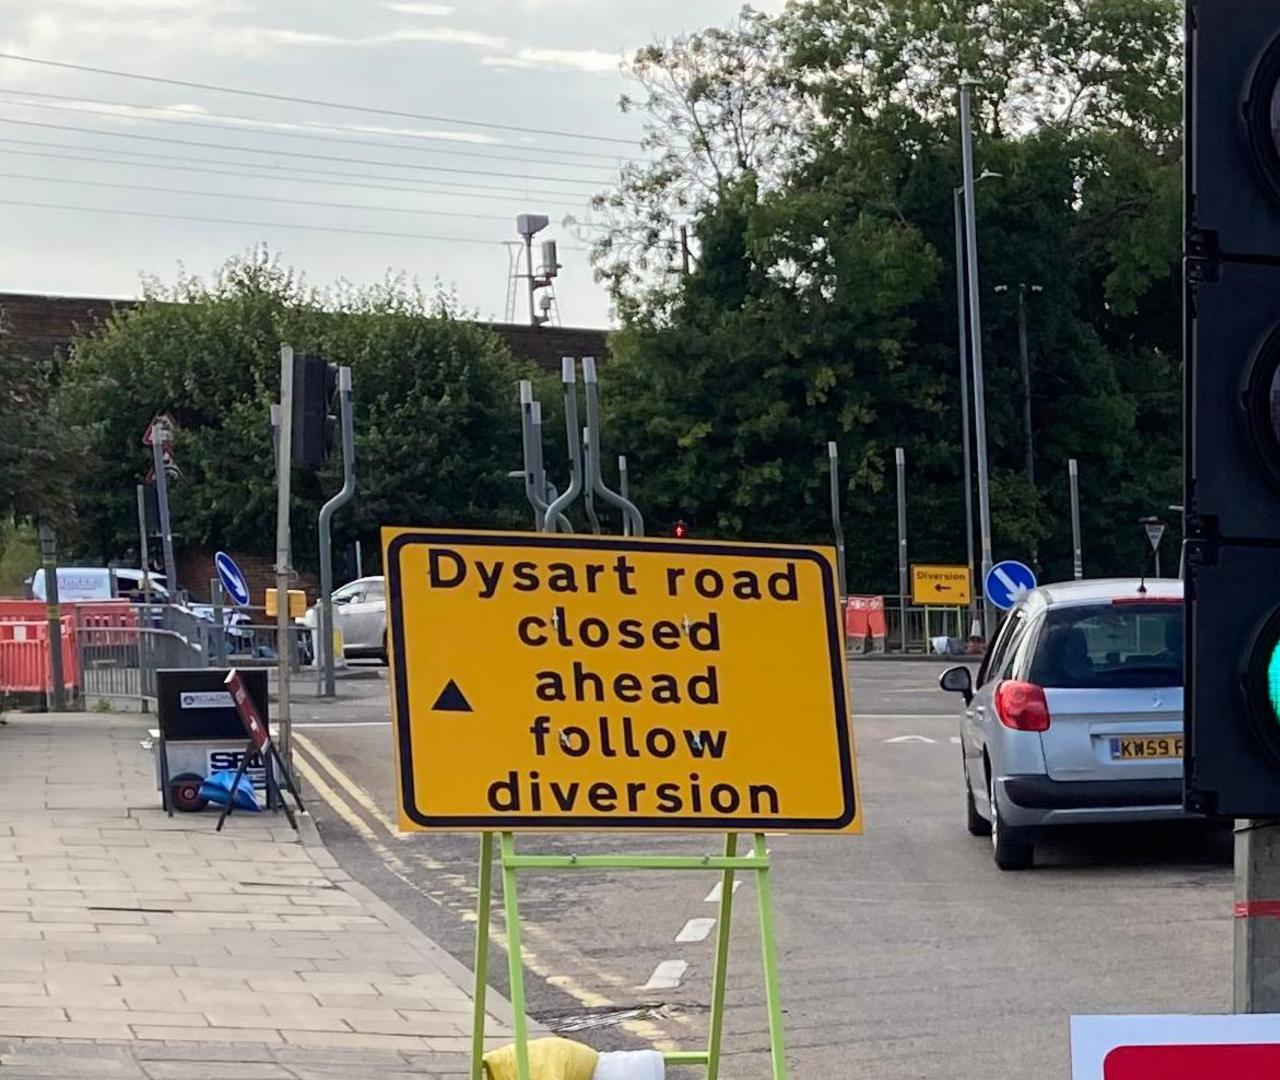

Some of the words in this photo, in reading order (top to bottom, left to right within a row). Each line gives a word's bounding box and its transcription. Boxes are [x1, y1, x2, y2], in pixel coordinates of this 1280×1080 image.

[428, 547, 637, 599] Dysart
[667, 563, 798, 602] road
[917, 571, 966, 580] Diversion
[518, 606, 720, 652] closed
[536, 662, 719, 705] ahead
[530, 716, 727, 759] follow
[487, 771, 779, 814] diversion
